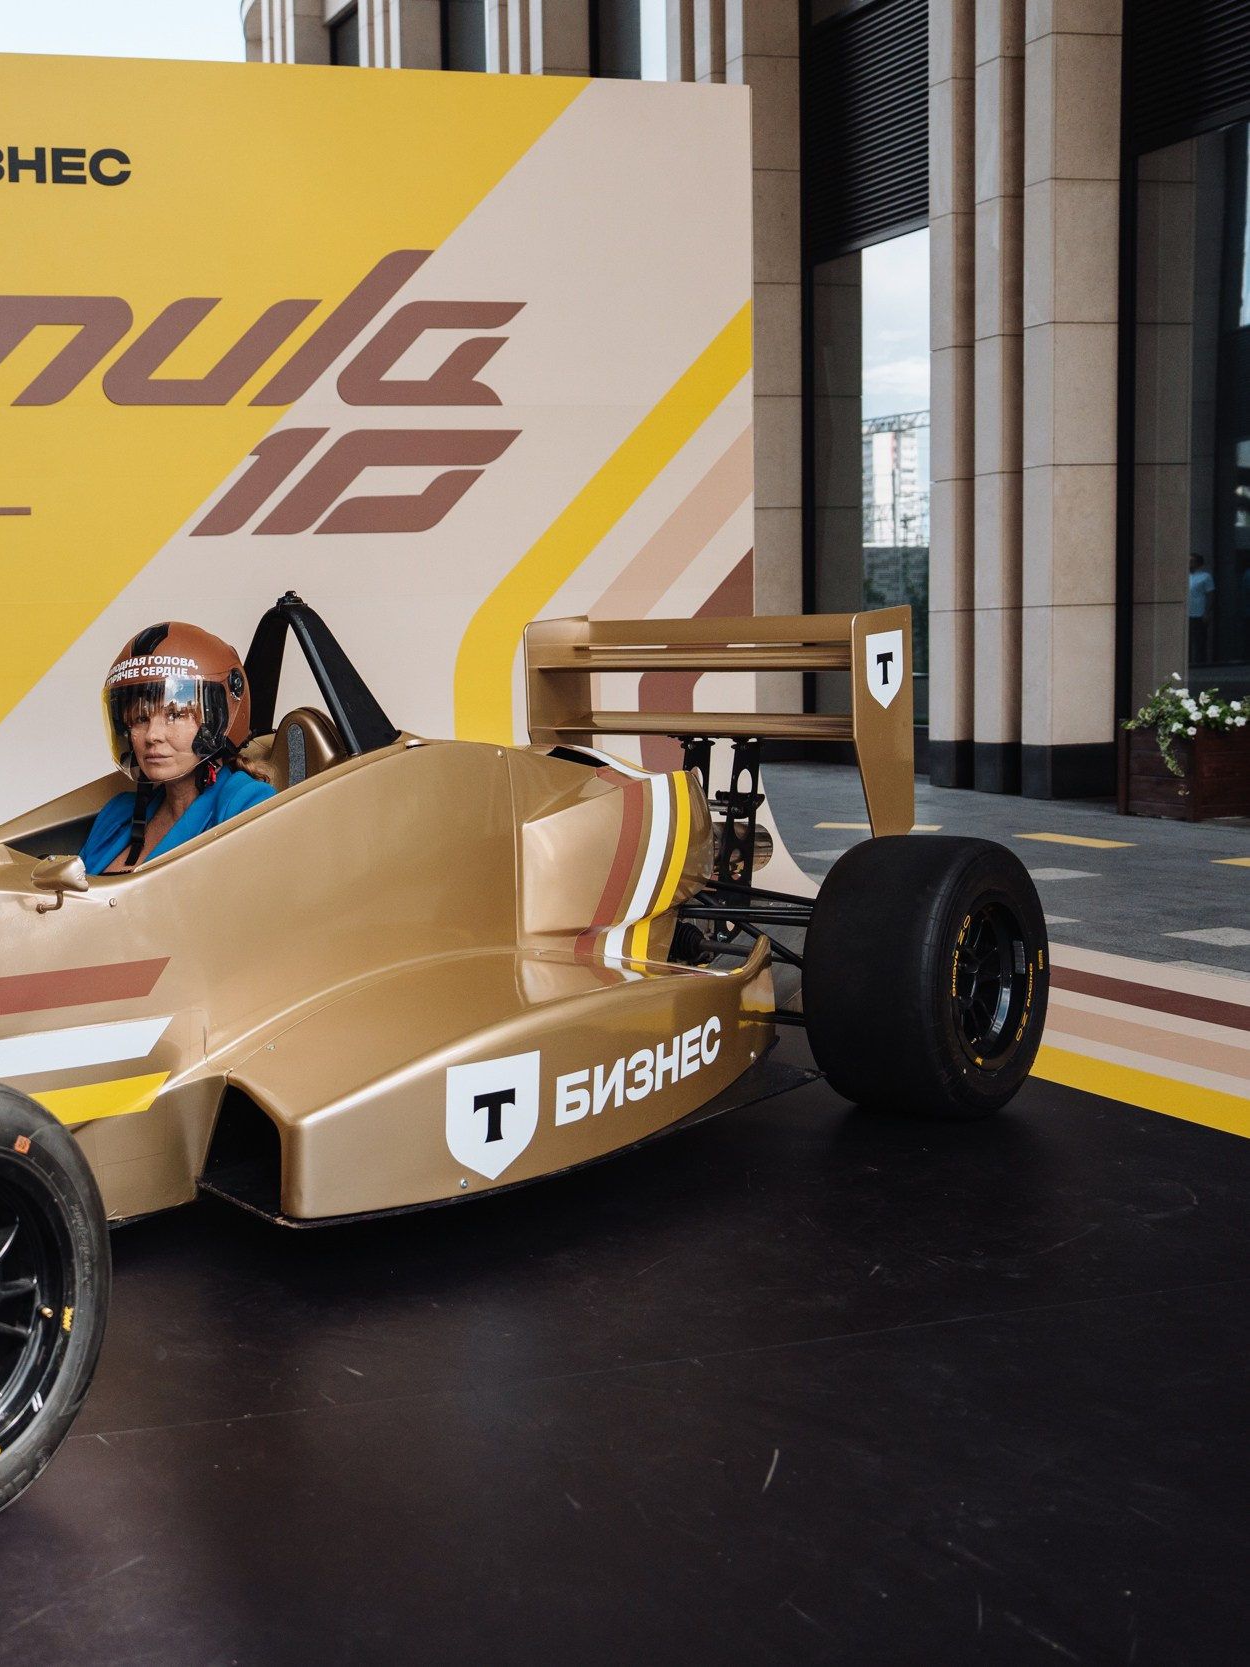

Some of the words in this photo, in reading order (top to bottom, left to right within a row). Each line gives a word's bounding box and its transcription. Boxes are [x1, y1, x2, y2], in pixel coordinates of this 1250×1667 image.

[141, 666, 188, 678] СЕРДЦЕ
[147, 655, 199, 670] ГОЛОВА,
[876, 651, 894, 686] Т
[473, 1087, 516, 1144] Т
[554, 1015, 721, 1127] БИЗНЕС
